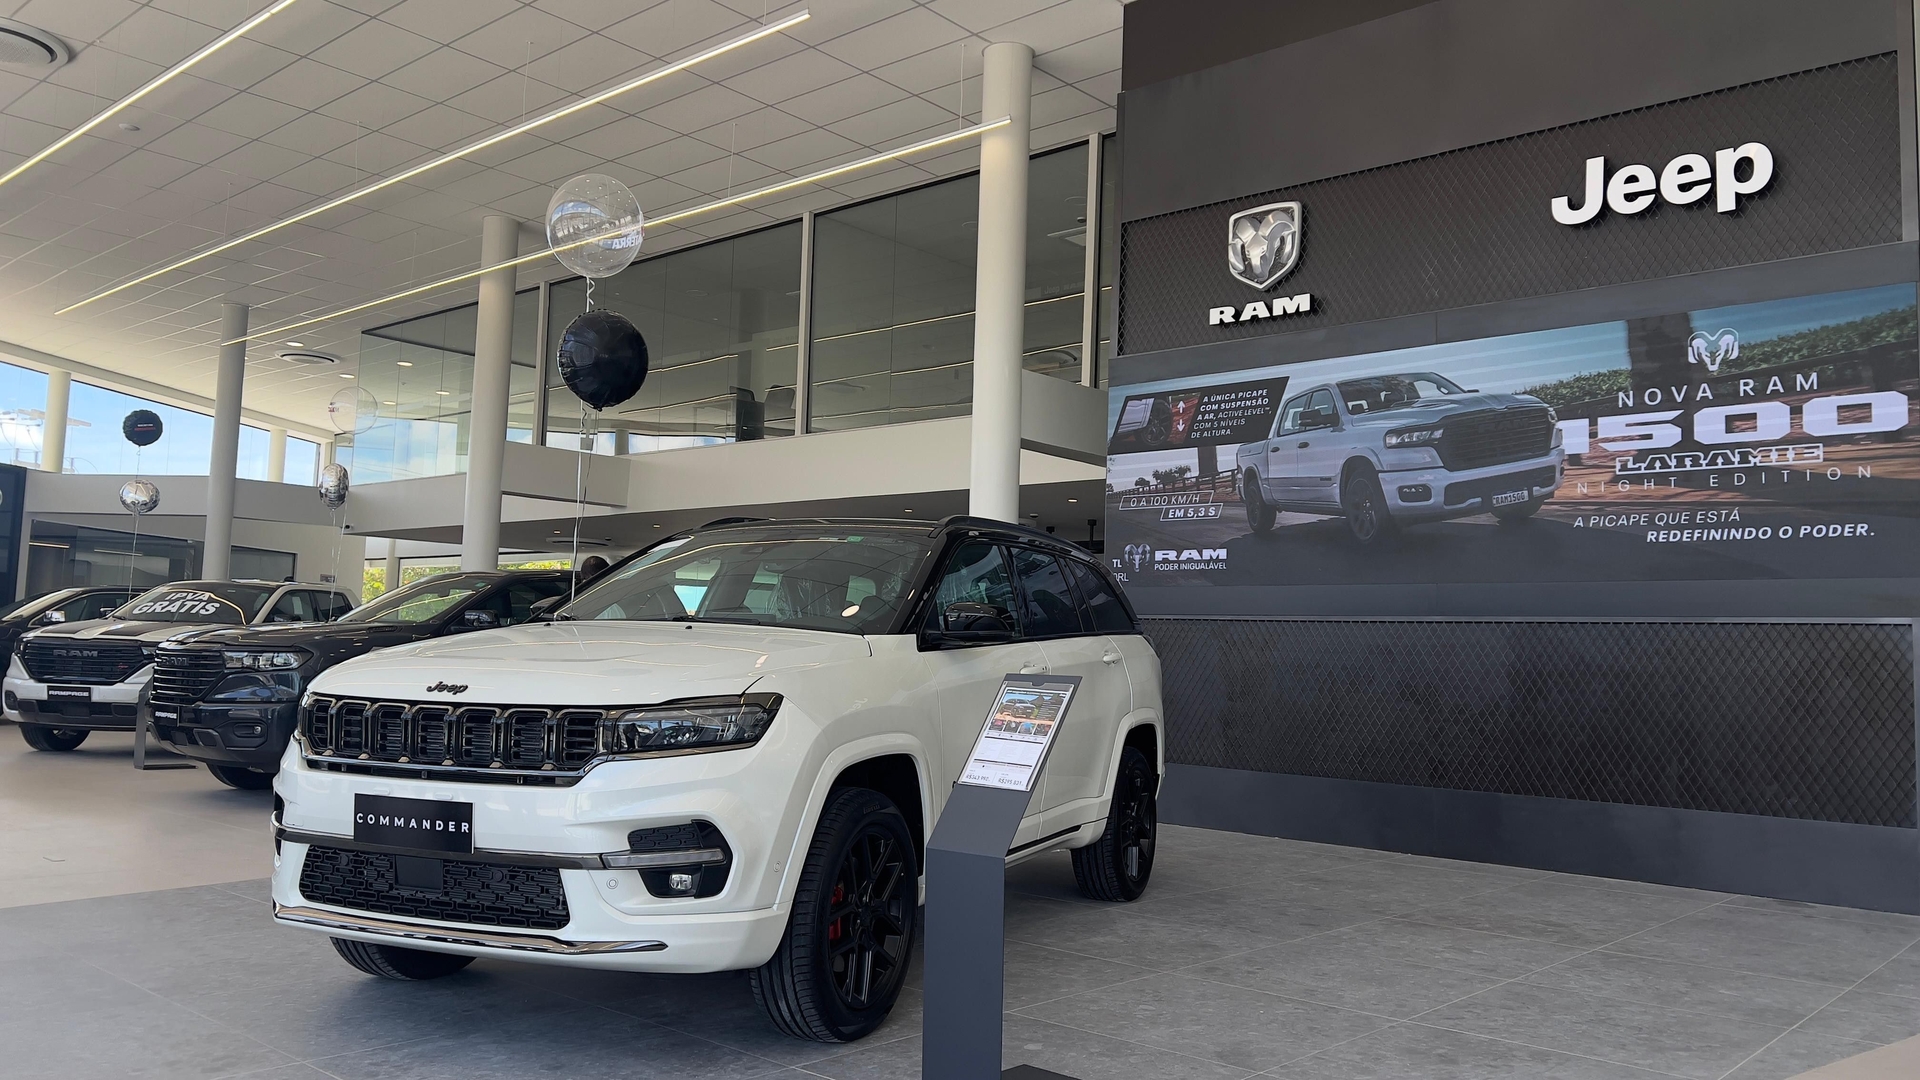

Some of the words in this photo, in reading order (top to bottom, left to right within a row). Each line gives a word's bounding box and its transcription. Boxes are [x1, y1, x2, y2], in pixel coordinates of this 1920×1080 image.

[1551, 140, 1774, 226] Jeep
[1209, 293, 1311, 326] RAM
[1211, 393, 1236, 402] ÚNICA
[1238, 389, 1268, 398] PICAPE
[1618, 383, 1714, 408] NOVA
[1739, 372, 1818, 397] RAM
[1200, 403, 1218, 412] COM
[1220, 398, 1269, 410] SUSPENSÃO
[1204, 412, 1216, 420] AR,
[1218, 410, 1243, 418] ACTIVE
[1193, 422, 1212, 430] COM
[1220, 418, 1246, 427] NÍVEIS
[1558, 390, 1909, 456] 1500
[1202, 429, 1234, 437] ALTURA.
[1615, 442, 1824, 475] LARAMIE
[1577, 476, 1677, 494] NIGHT
[1709, 465, 1871, 488] EDITION
[1140, 498, 1147, 506] A
[1150, 496, 1168, 506] 100
[1170, 494, 1200, 504] KM/H
[1168, 508, 1184, 518] EM
[1187, 507, 1205, 518] 5,3
[1208, 506, 1216, 516] S
[1573, 516, 1584, 528] A
[1589, 513, 1650, 528] PICAPE
[1654, 512, 1690, 526] QUE
[1696, 507, 1741, 524] ESTÁ
[1646, 526, 1772, 543] REDEFININDO
[1778, 526, 1793, 540] O
[1799, 523, 1876, 538] PODER.
[1154, 548, 1228, 562] RAM
[1154, 562, 1179, 571] PODER
[1180, 560, 1227, 570] INIGUALÁVEL
[164, 592, 210, 601] IPVA
[53, 649, 98, 658] RAM
[158, 656, 189, 666] RAM
[426, 681, 468, 695] Jeep
[356, 812, 470, 833] COMMANDER
